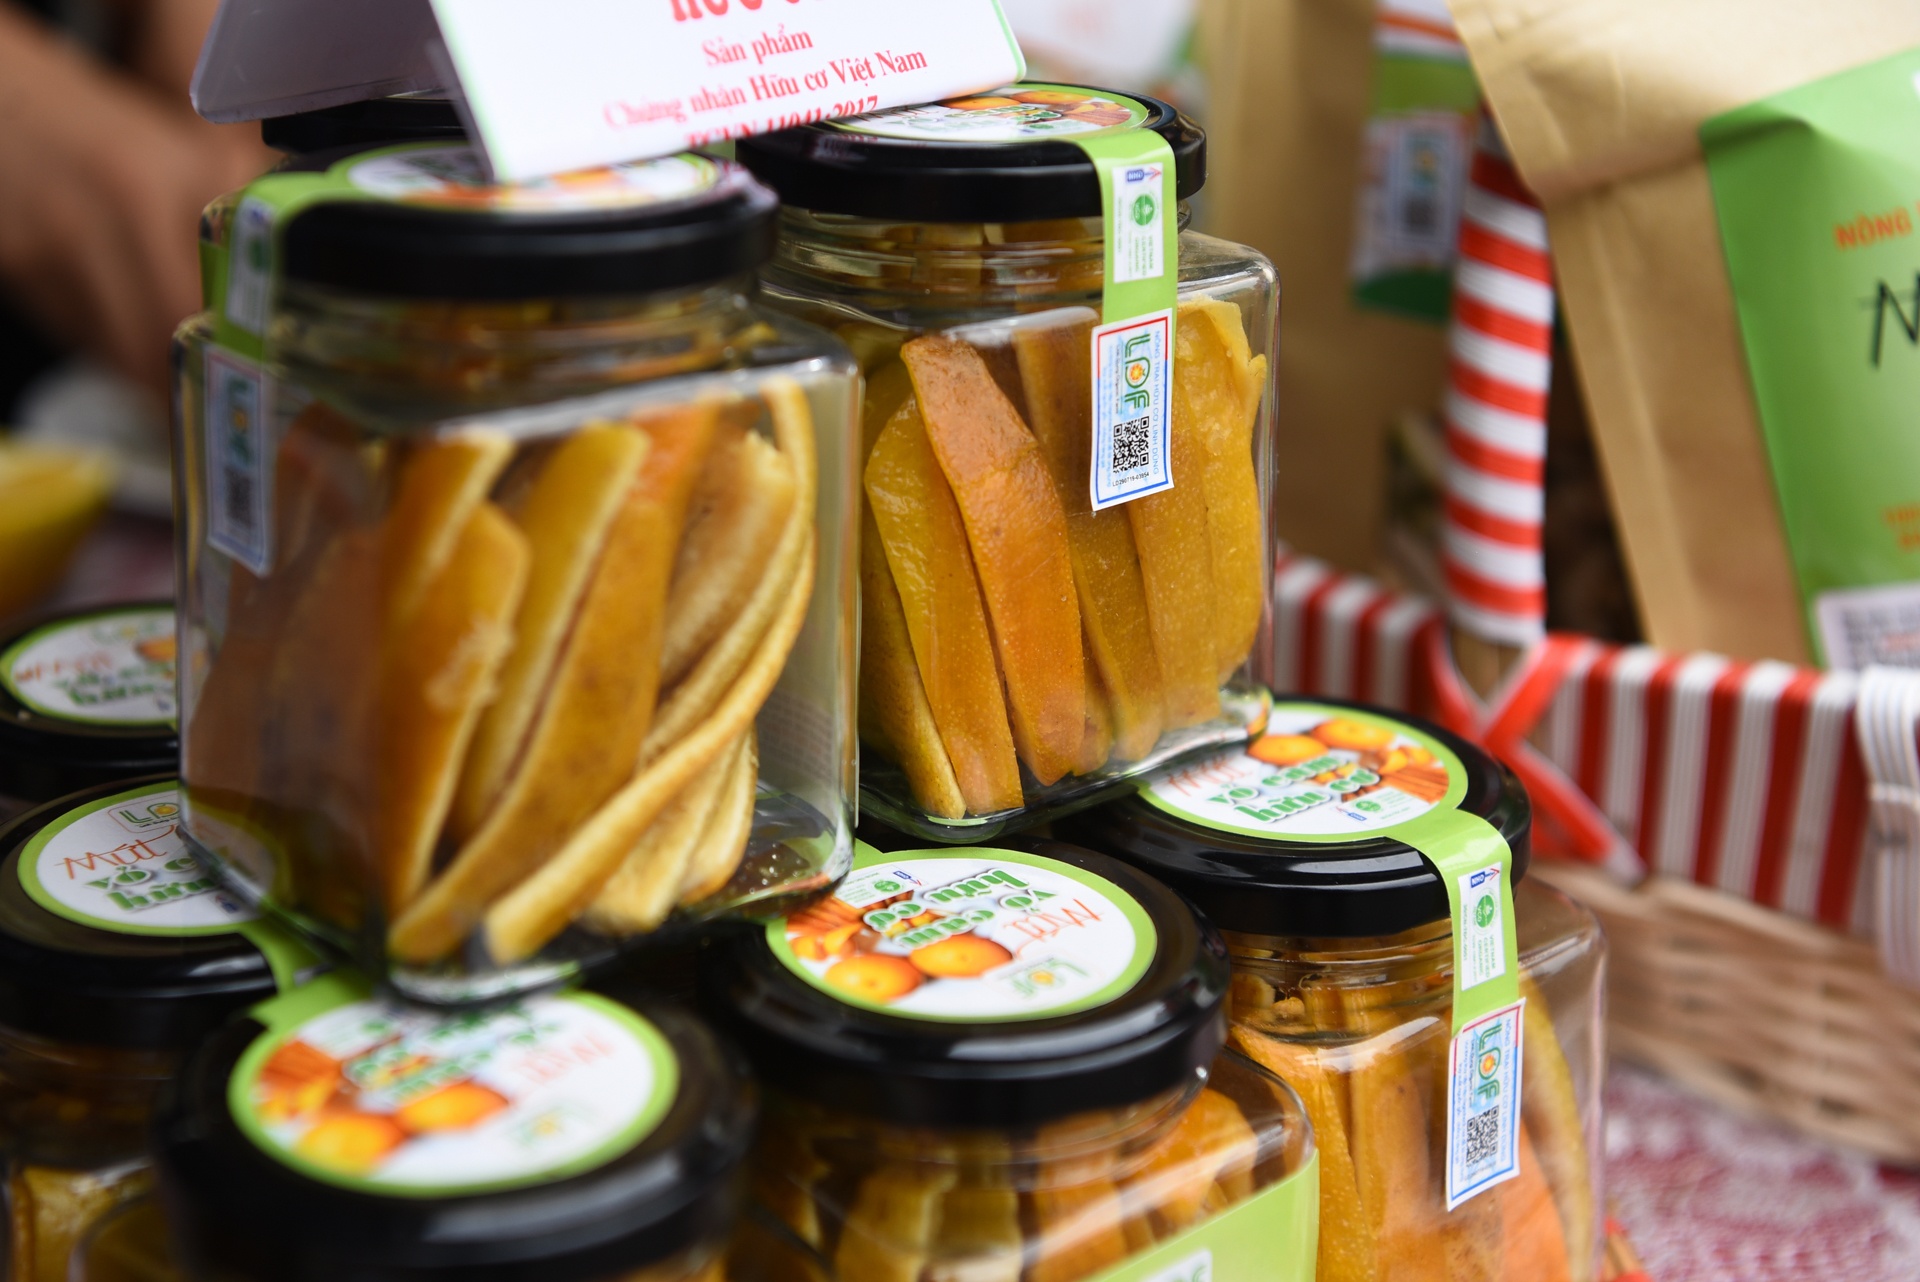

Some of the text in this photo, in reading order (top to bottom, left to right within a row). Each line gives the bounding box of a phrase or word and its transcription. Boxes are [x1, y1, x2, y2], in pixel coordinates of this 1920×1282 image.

[702, 23, 813, 67] Sản phẩm
[749, 73, 801, 101] Hữu
[804, 69, 829, 91] cơ
[829, 57, 876, 87] Việt
[874, 50, 928, 76] Nam
[1152, 423, 1160, 445] LINH
[1207, 756, 1341, 804] vỏ cam
[1234, 768, 1376, 822] hữu cơ
[868, 869, 1029, 931] hữu cơ
[901, 889, 1058, 947] vỏ cam
